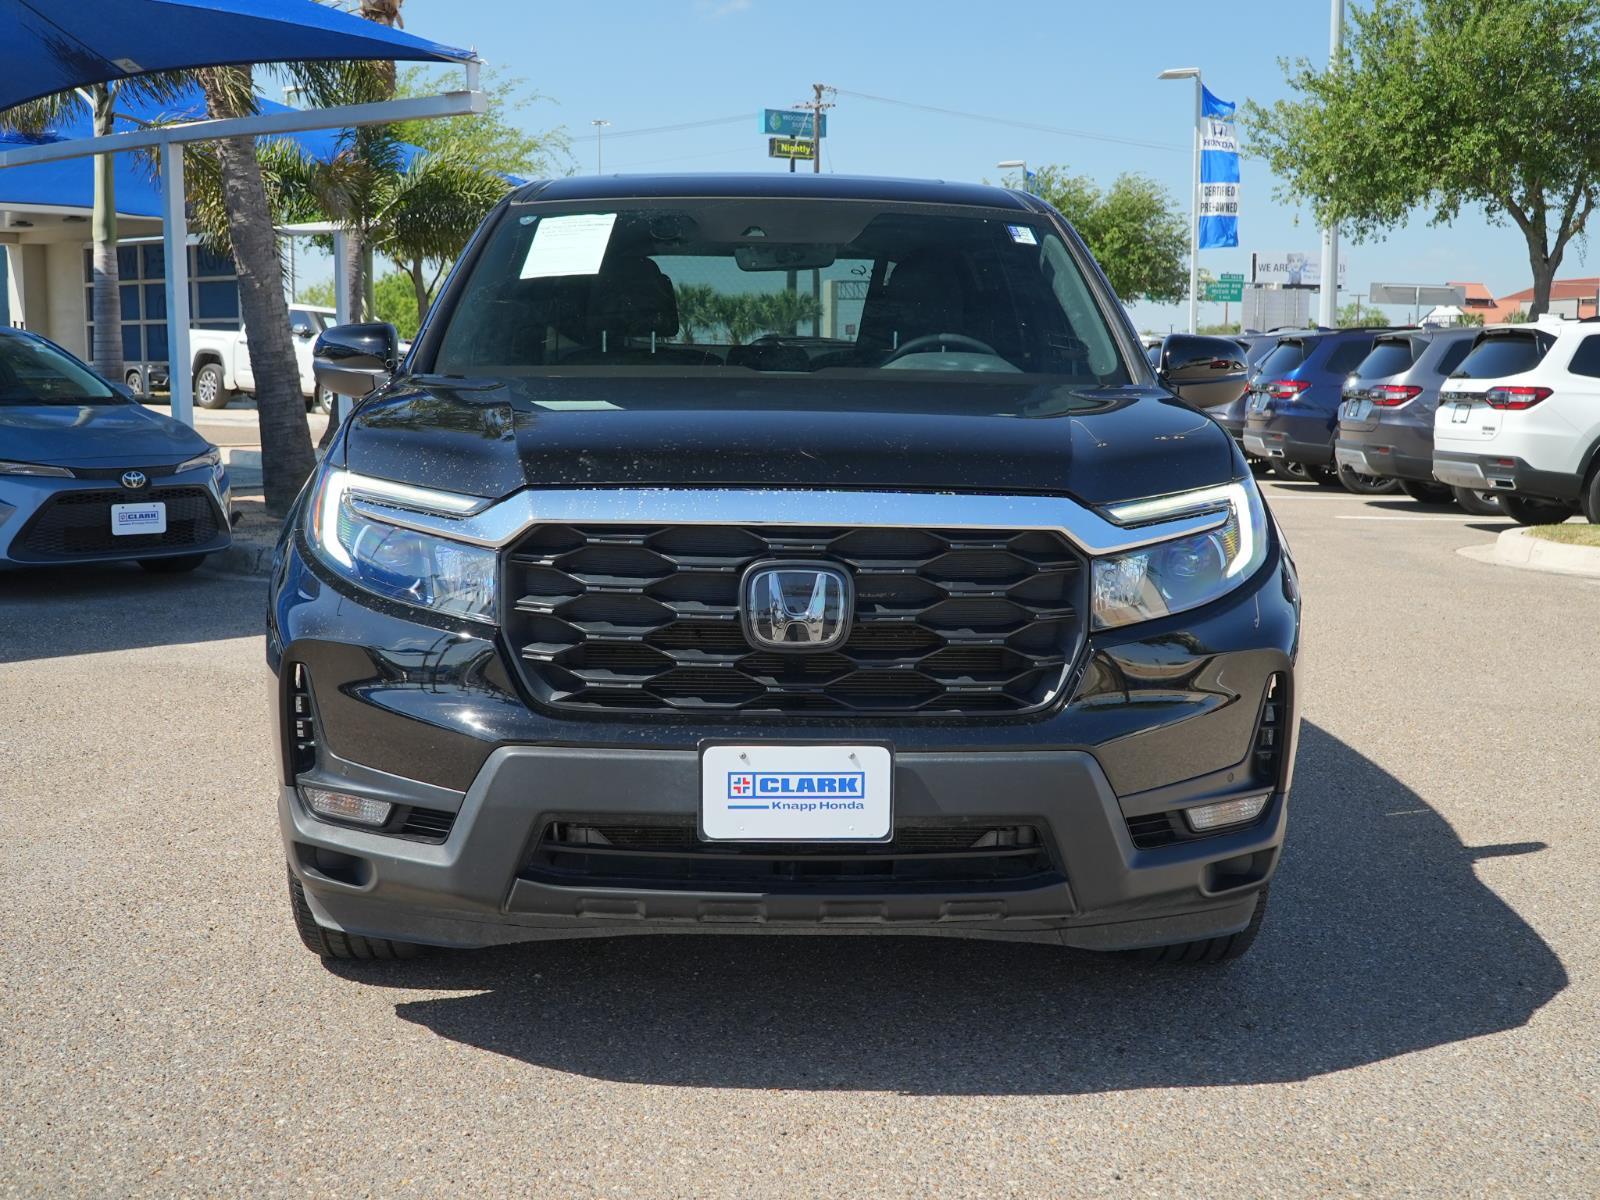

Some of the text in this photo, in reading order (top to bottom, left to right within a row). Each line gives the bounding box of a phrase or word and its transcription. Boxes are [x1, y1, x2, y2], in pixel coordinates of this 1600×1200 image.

[781, 143, 811, 155] Nightly
[1203, 138, 1234, 149] HONDA
[1204, 185, 1235, 197] CERTIFIED
[1200, 202, 1238, 213] PRE-OWNED
[1258, 263, 1288, 273] WE ARE
[759, 777, 858, 793] CLARK
[772, 801, 865, 812] Knapp Honda
